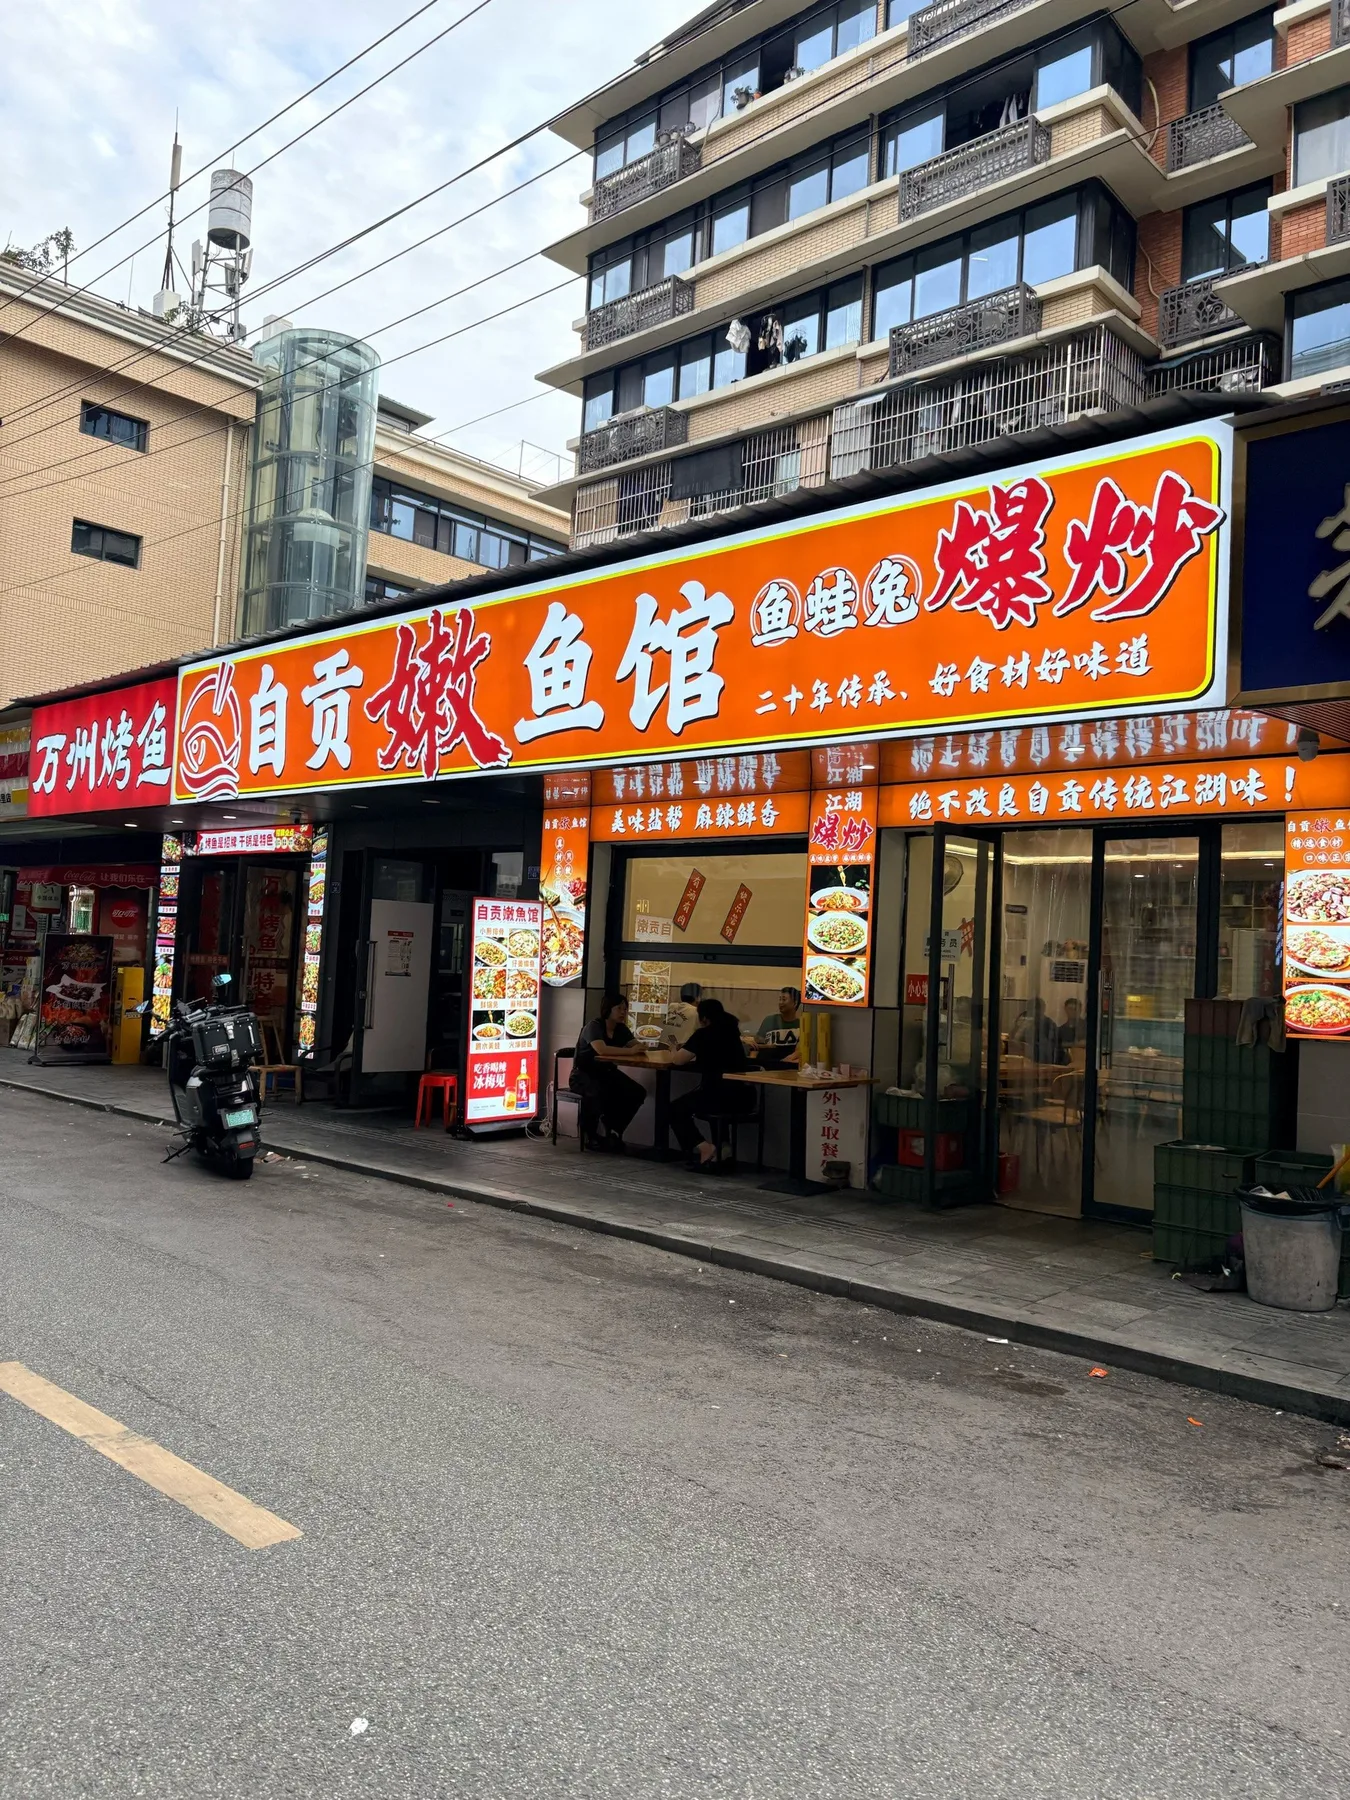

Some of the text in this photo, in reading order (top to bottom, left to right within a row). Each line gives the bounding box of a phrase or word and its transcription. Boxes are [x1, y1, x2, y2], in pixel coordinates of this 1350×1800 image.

[925, 470, 1226, 630] 爆炒
[750, 556, 921, 648] 鱼蛙兔
[249, 580, 734, 780] 自贡嫩鱼馆
[33, 700, 171, 794] 万州烤鱼
[611, 799, 780, 834] 美味盐帮 麻辣鲜香
[825, 791, 862, 812] 江湖
[239, 833, 273, 849] 干锅是特色
[544, 816, 588, 831] 自贡嫩鱼馆
[811, 812, 874, 851] 爆炒
[1287, 818, 1350, 832] 自贡嫩鱼
[473, 1061, 507, 1074] 吃香喝辣
[473, 1073, 506, 1090] 冰梅见
[820, 1091, 841, 1168] 外卖取餐
